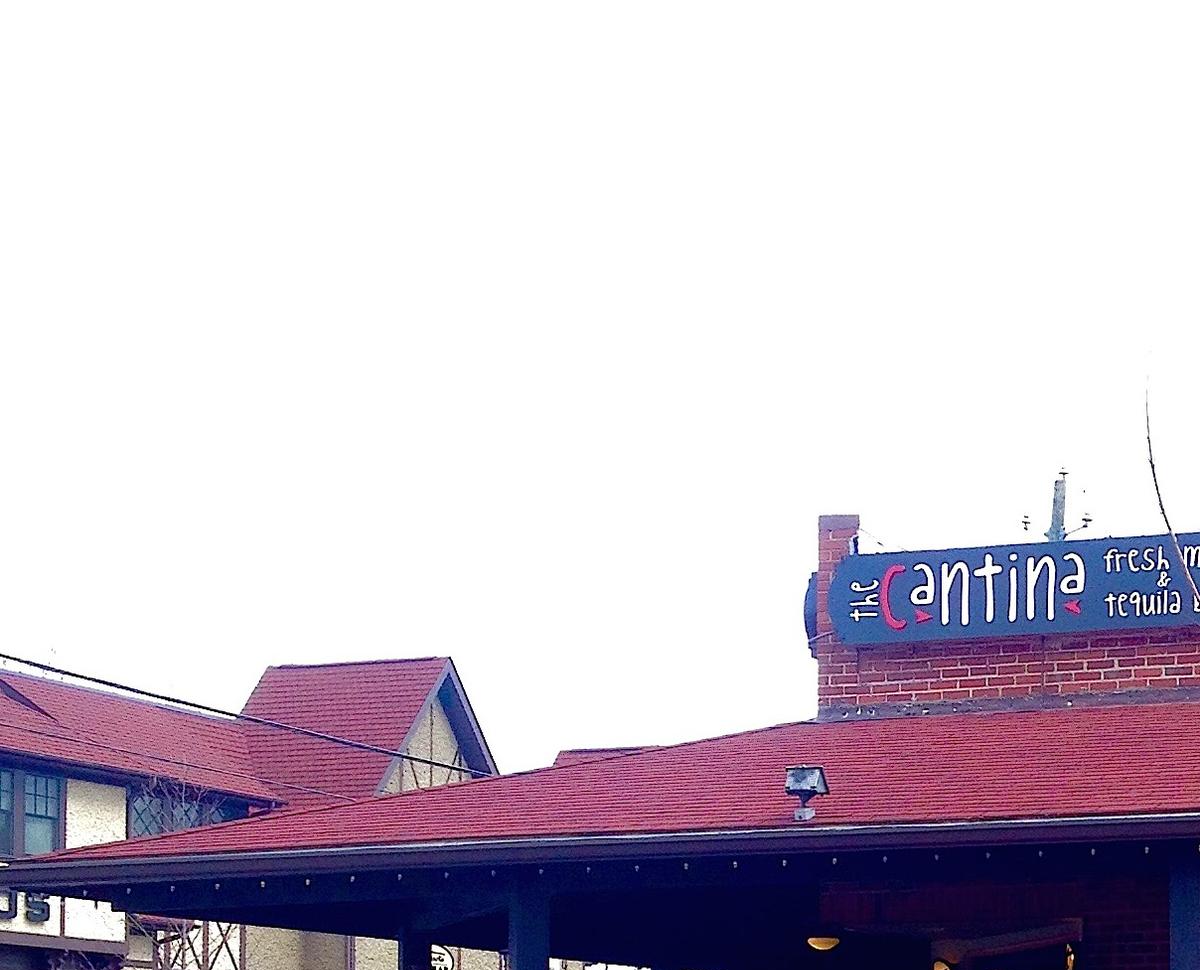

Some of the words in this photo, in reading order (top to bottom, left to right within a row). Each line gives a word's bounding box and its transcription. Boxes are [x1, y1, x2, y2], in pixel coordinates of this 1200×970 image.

[1103, 545, 1170, 573] fresh
[850, 580, 879, 622] the
[881, 552, 1086, 631] Cantina
[1156, 571, 1172, 587] &
[1104, 589, 1181, 617] tequila
